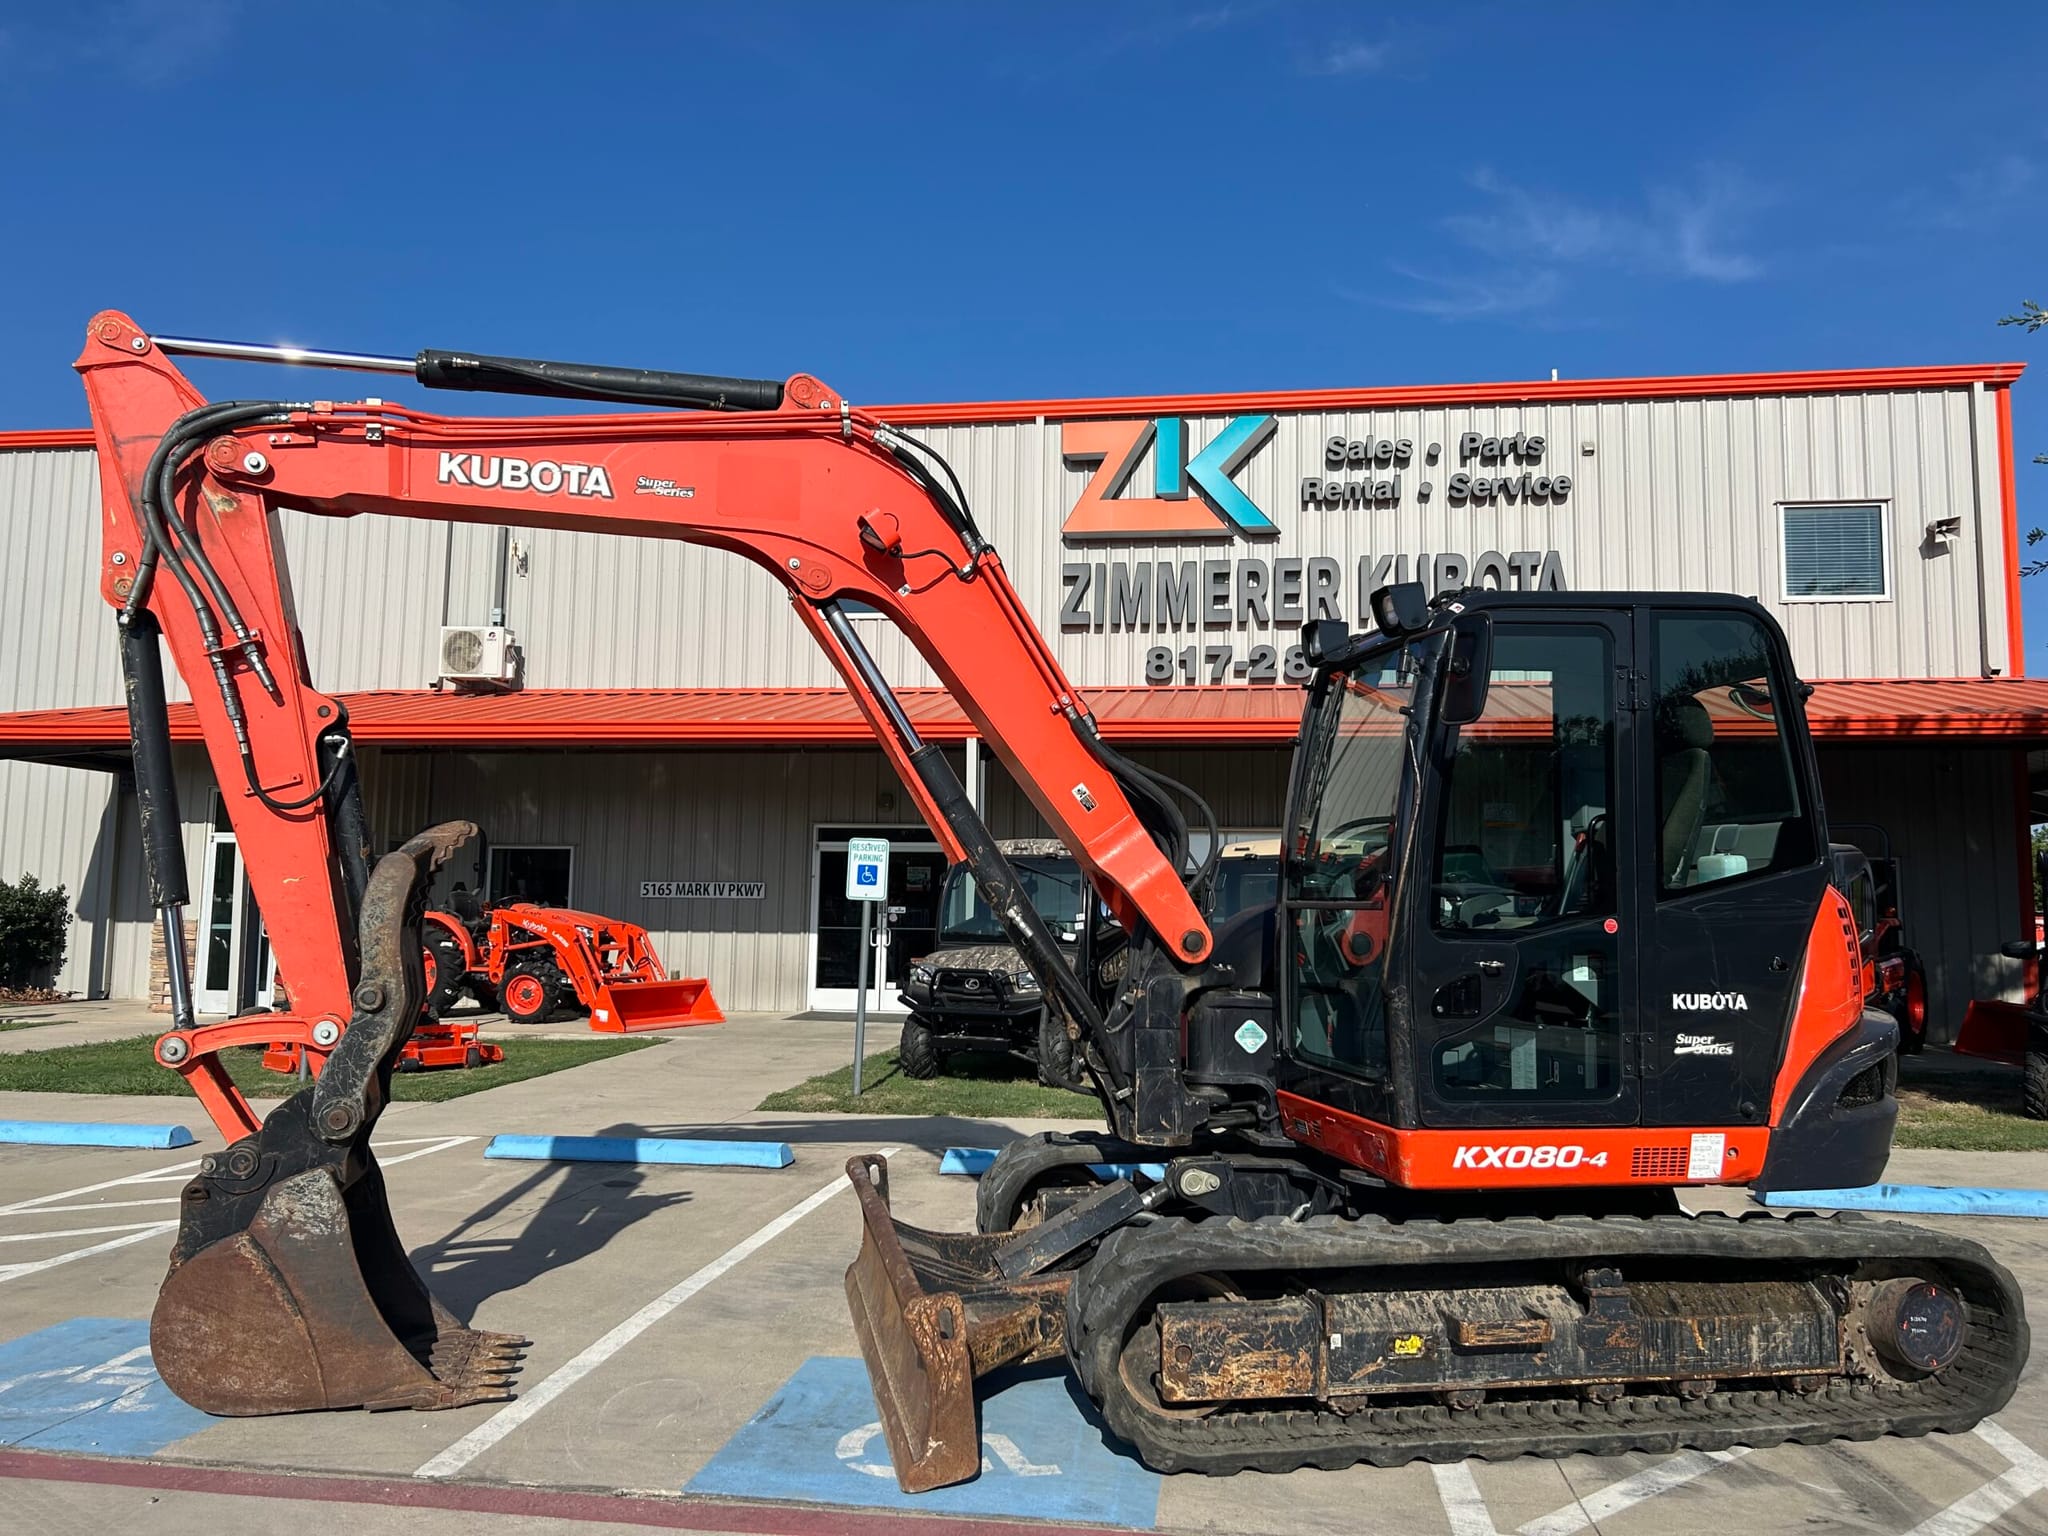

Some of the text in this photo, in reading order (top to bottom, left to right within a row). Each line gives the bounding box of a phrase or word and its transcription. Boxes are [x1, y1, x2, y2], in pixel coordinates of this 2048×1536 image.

[1326, 431, 1546, 464] Sales Parts
[438, 450, 613, 498] KUBOTA
[637, 476, 676, 488] Super
[1302, 473, 1572, 504] Rental Service
[655, 487, 695, 498] Series
[1061, 556, 1342, 627] ZIMMERER
[852, 843, 886, 852] RESERVED
[853, 853, 884, 862] PARKING
[642, 883, 763, 897] 5165 MARK IV PKWY
[1672, 991, 1748, 1010] KUBOTA
[1675, 1033, 1714, 1046] Super
[1694, 1042, 1733, 1055] Series
[1452, 1145, 1608, 1169] KX080-4
